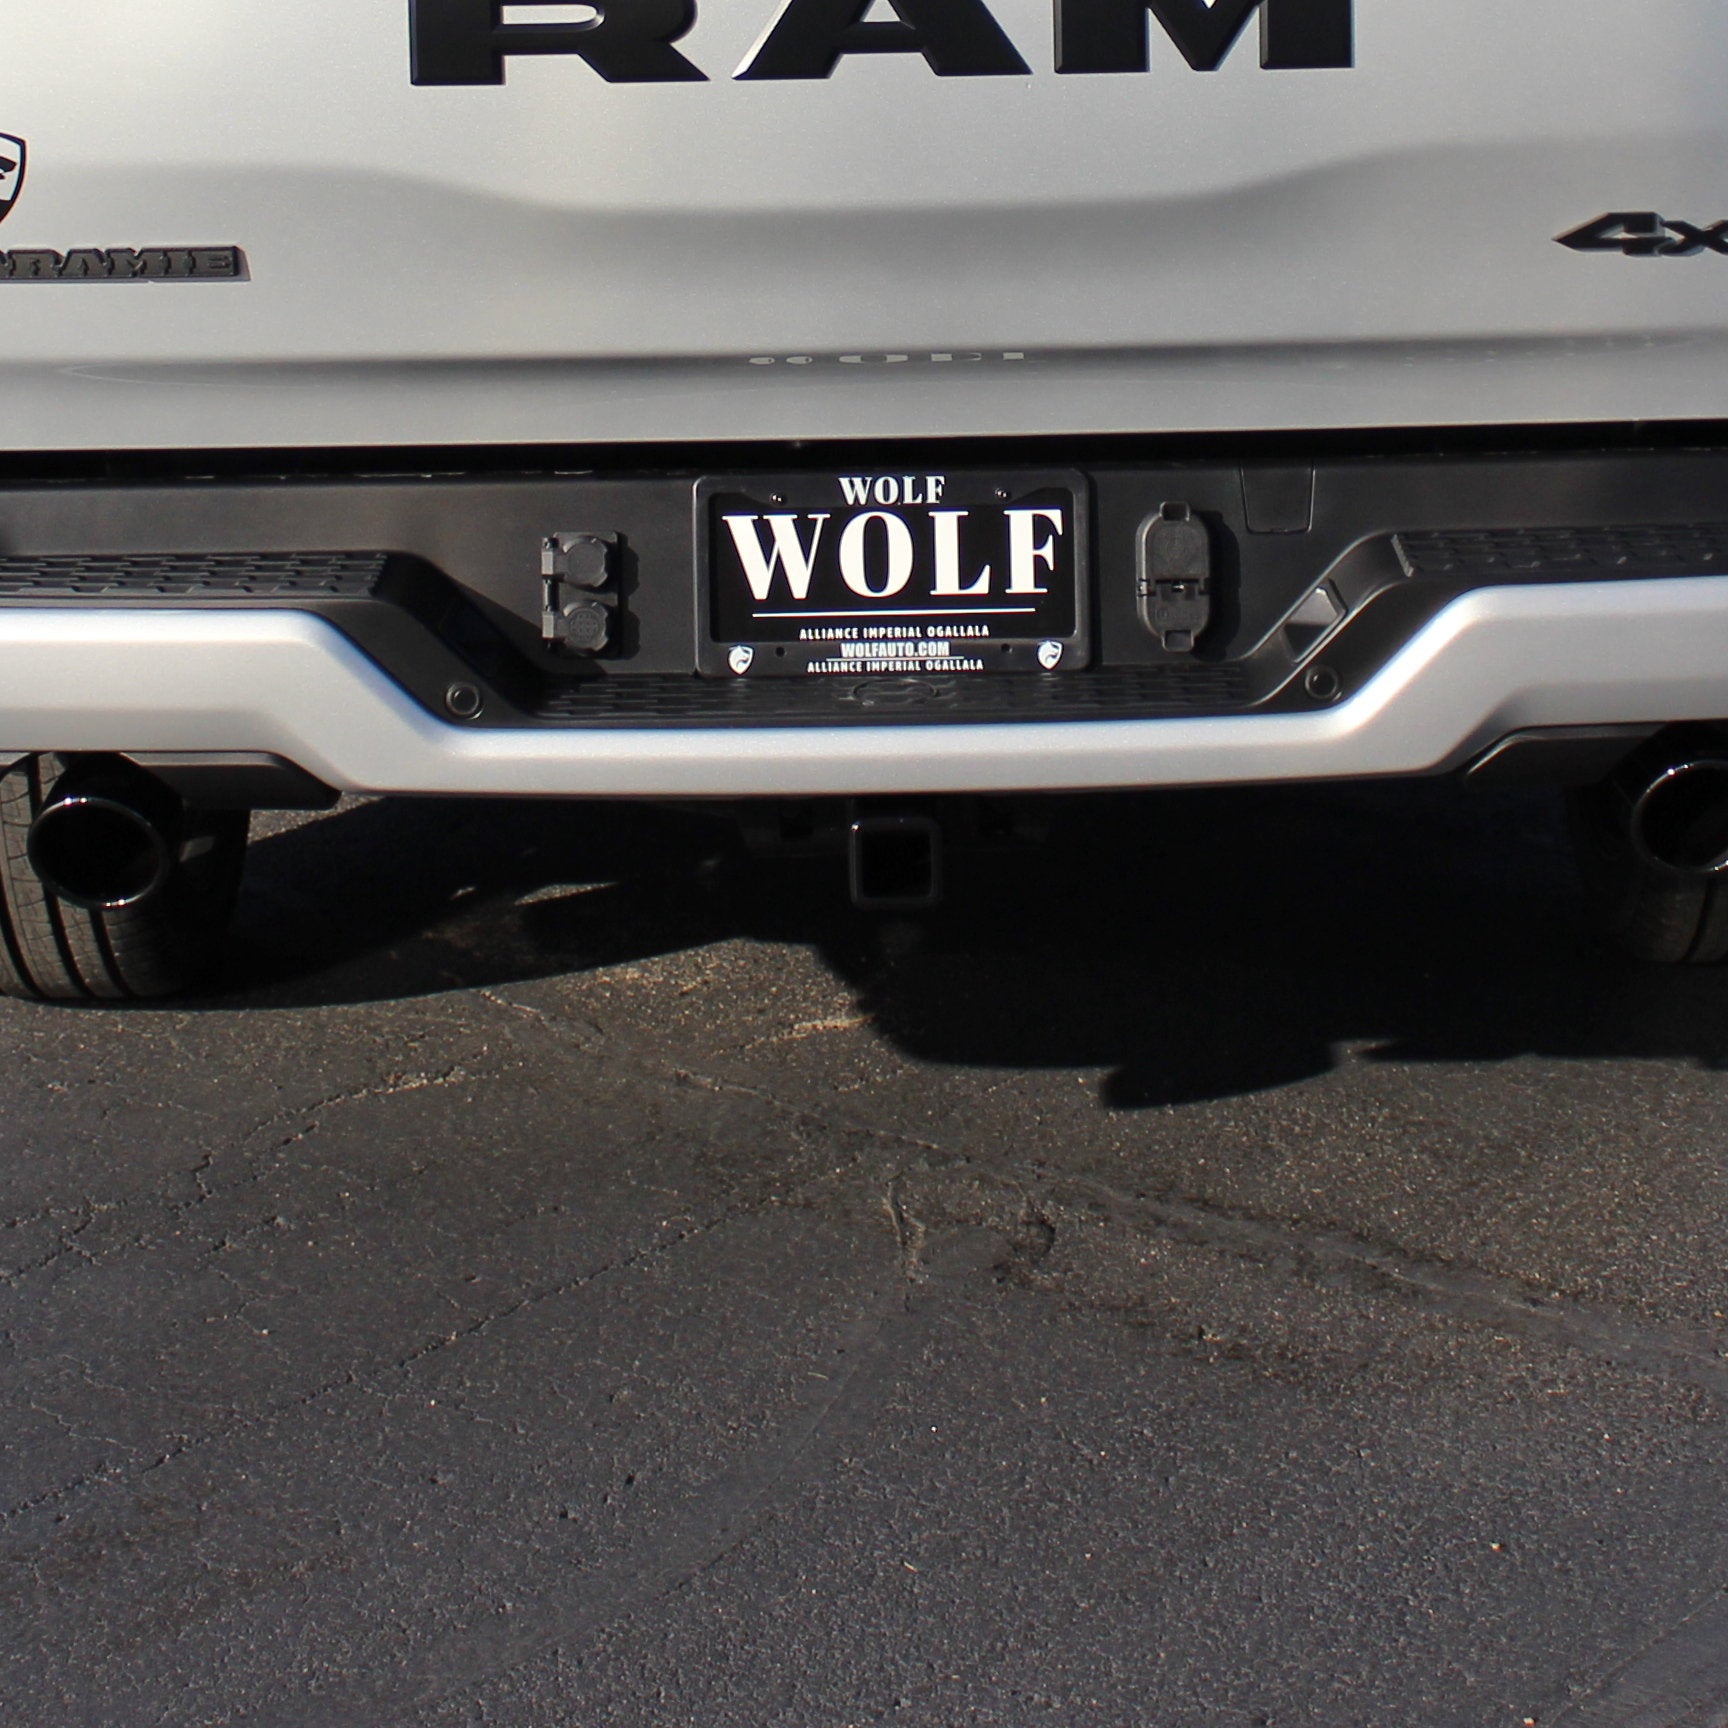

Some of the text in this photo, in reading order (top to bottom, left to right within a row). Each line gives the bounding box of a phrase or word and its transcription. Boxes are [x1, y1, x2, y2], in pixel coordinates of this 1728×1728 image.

[838, 475, 945, 505] WOLF
[722, 508, 1064, 600] WOLF
[799, 625, 989, 640] ALLIANCE IMPERIAL OGALLALA
[840, 641, 950, 658] WOLFAUTO.COM
[807, 658, 984, 673] ALLIANCE IMPERIAL OGALLALA
